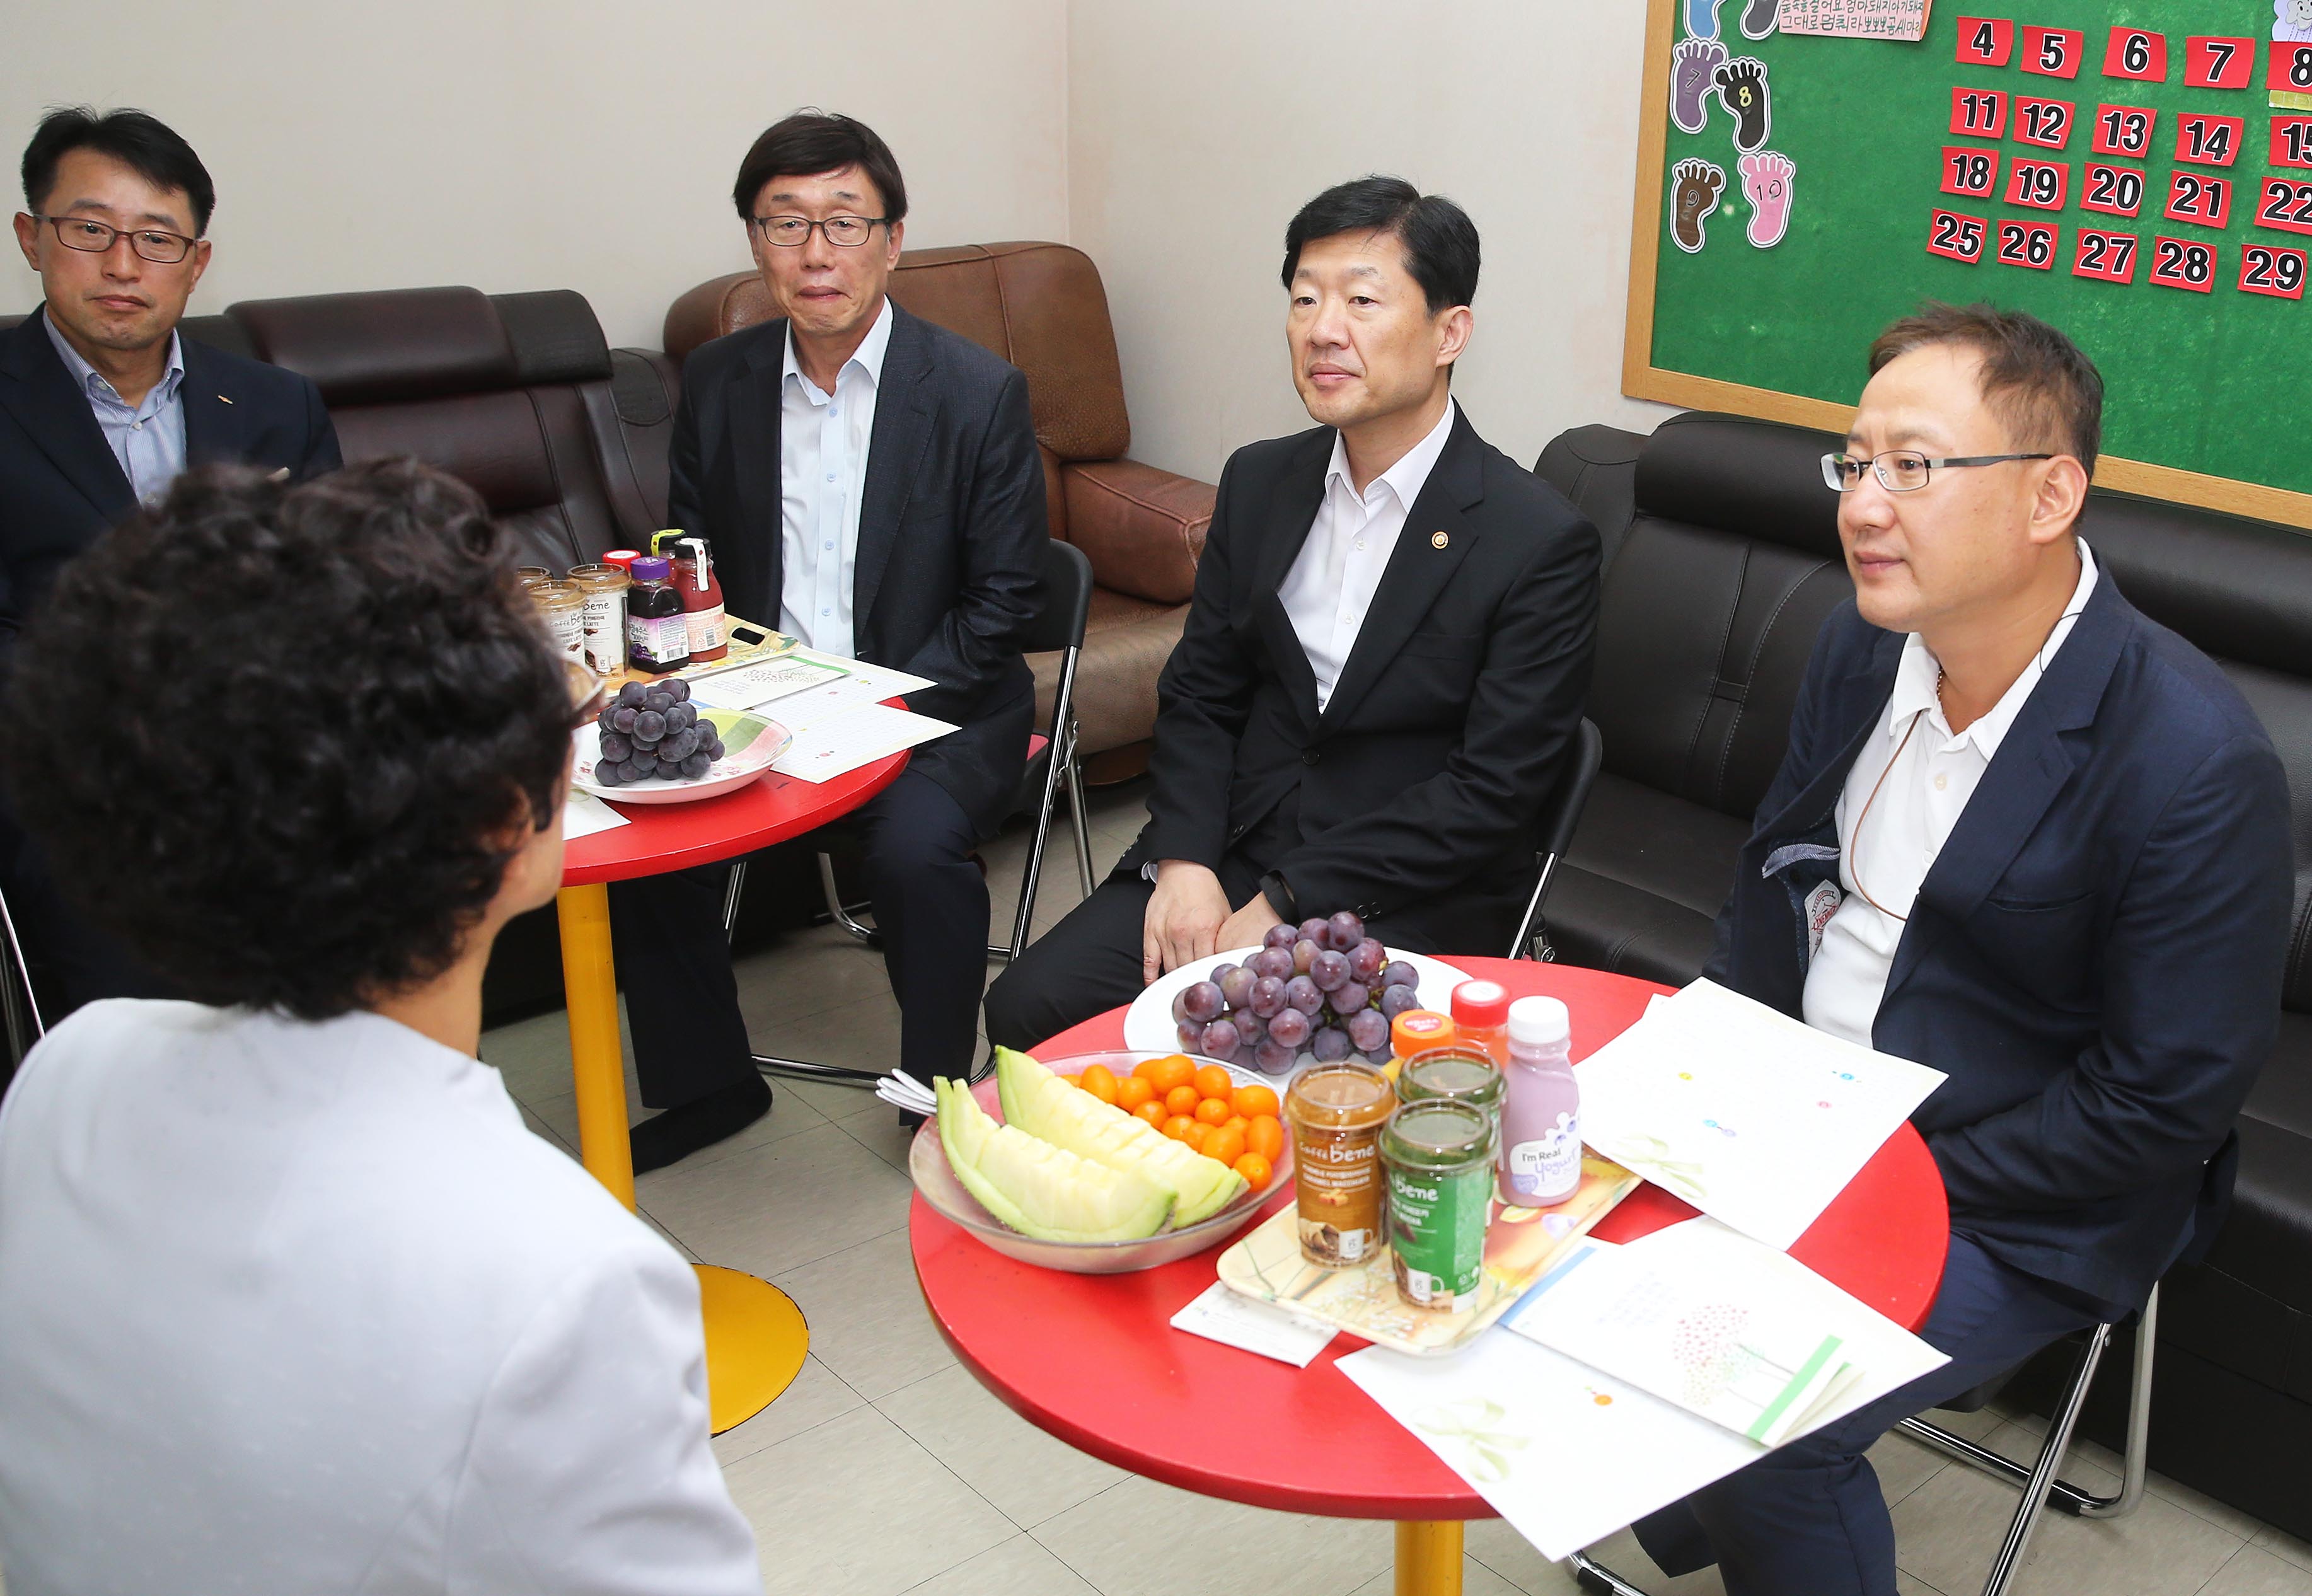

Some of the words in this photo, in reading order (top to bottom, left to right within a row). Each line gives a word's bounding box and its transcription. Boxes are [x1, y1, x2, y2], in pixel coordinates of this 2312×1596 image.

[1971, 22, 1995, 57] 4
[2039, 33, 2066, 71] 5
[2123, 33, 2150, 73] 6
[2206, 42, 2235, 82] 7
[2289, 47, 2312, 88] 8
[1685, 68, 1701, 88] 7
[1738, 86, 1752, 107] 8
[1962, 93, 1997, 130] 11
[2023, 103, 2066, 143] 12
[2103, 110, 2147, 152] 13
[2185, 120, 2231, 162] 14
[1686, 190, 1699, 207] 9
[1756, 180, 1783, 201] 10
[1951, 154, 1991, 191] 18
[2017, 165, 2058, 204] 19
[2088, 167, 2143, 211] 20
[2171, 176, 2222, 218] 21
[2263, 182, 2312, 225] 22
[1933, 214, 1983, 257] 25
[2001, 225, 2052, 265] 26
[2079, 233, 2135, 275] 27
[2156, 241, 2210, 282] 28
[2244, 248, 2304, 291] 29
[1522, 1154, 1537, 1162] I'm
[1539, 1148, 1561, 1160] Real
